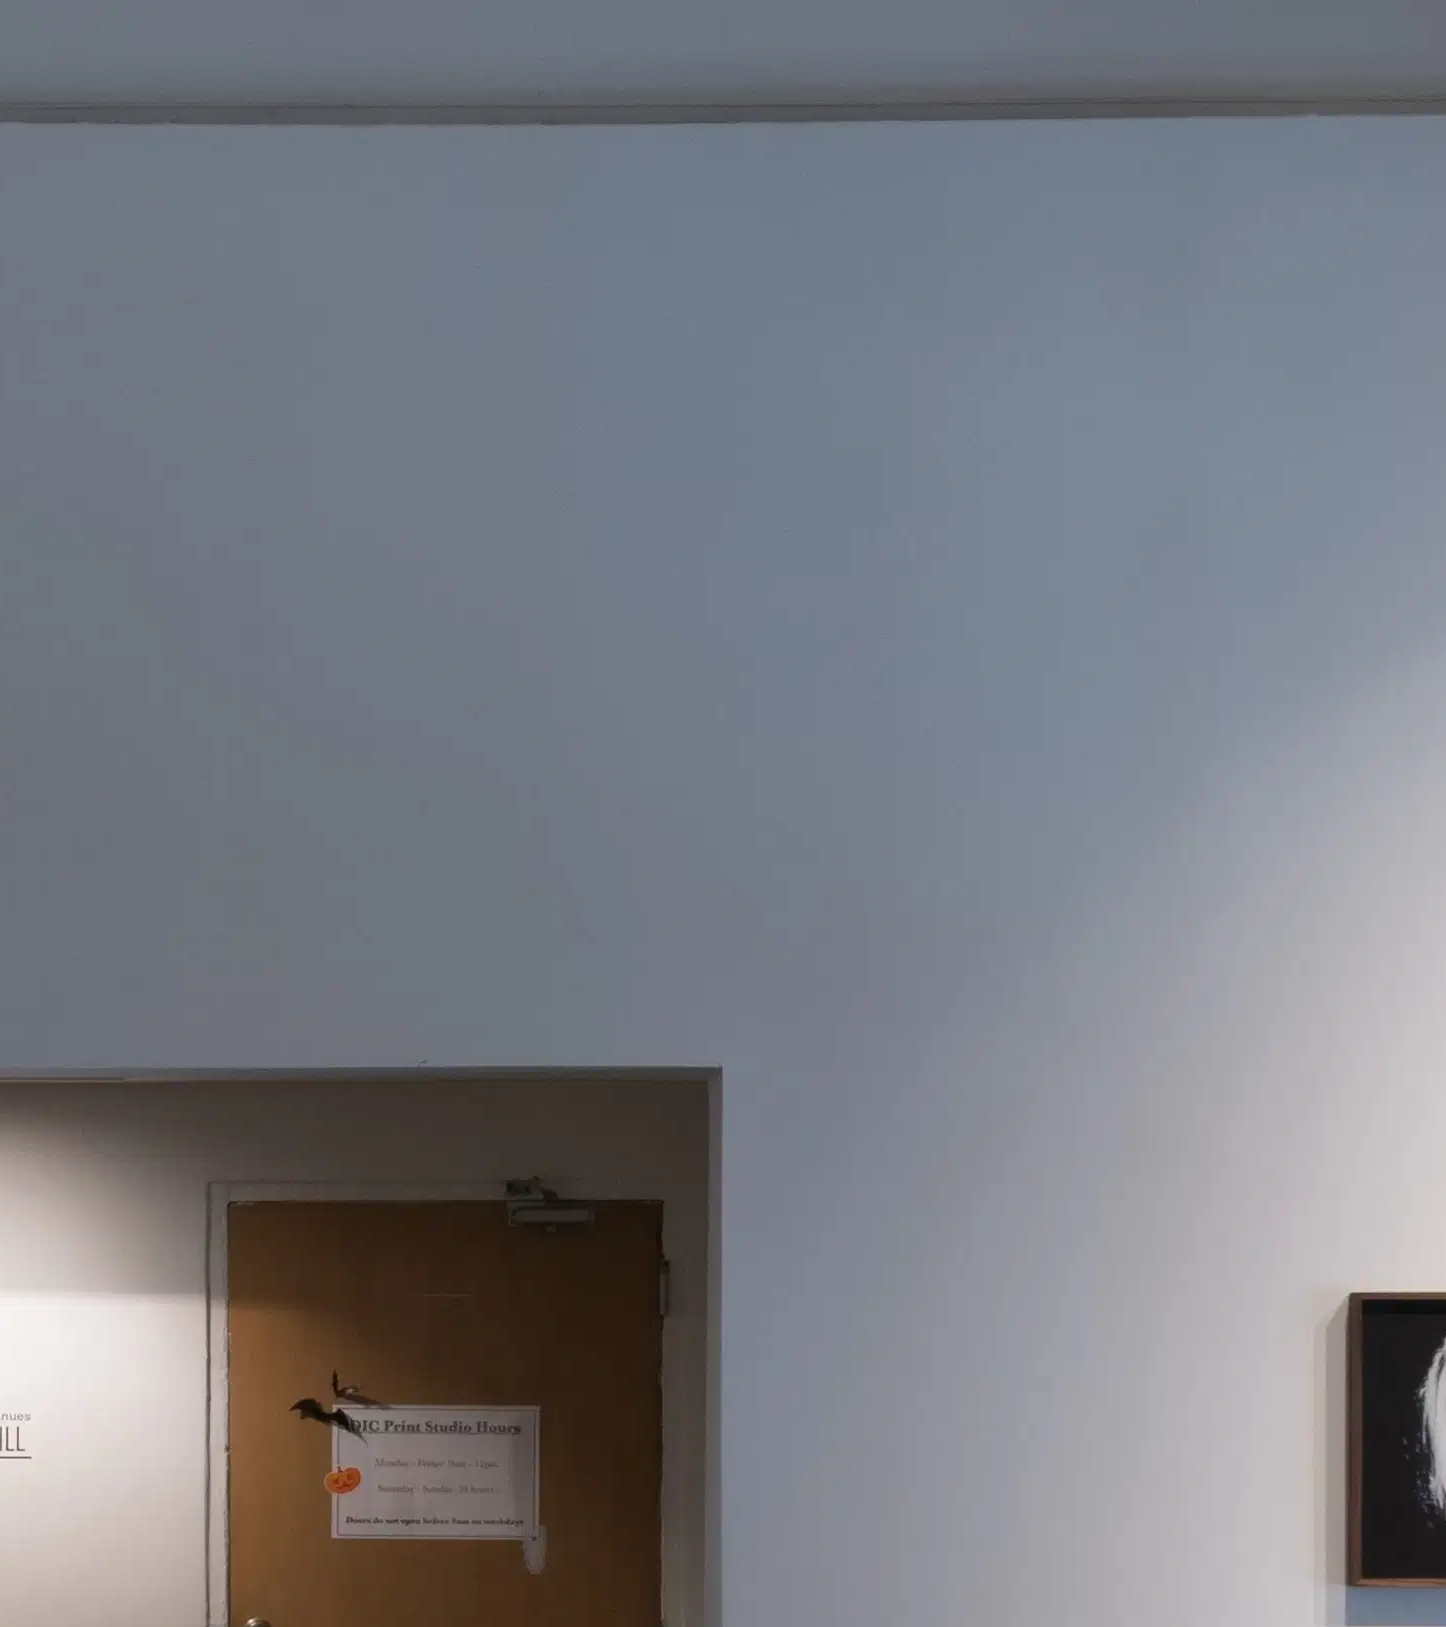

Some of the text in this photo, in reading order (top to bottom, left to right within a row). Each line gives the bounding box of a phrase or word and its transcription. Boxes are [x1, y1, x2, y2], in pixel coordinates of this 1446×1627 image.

[384, 1419, 421, 1433] Print
[425, 1420, 471, 1433] Studio
[476, 1420, 521, 1434] Hours
